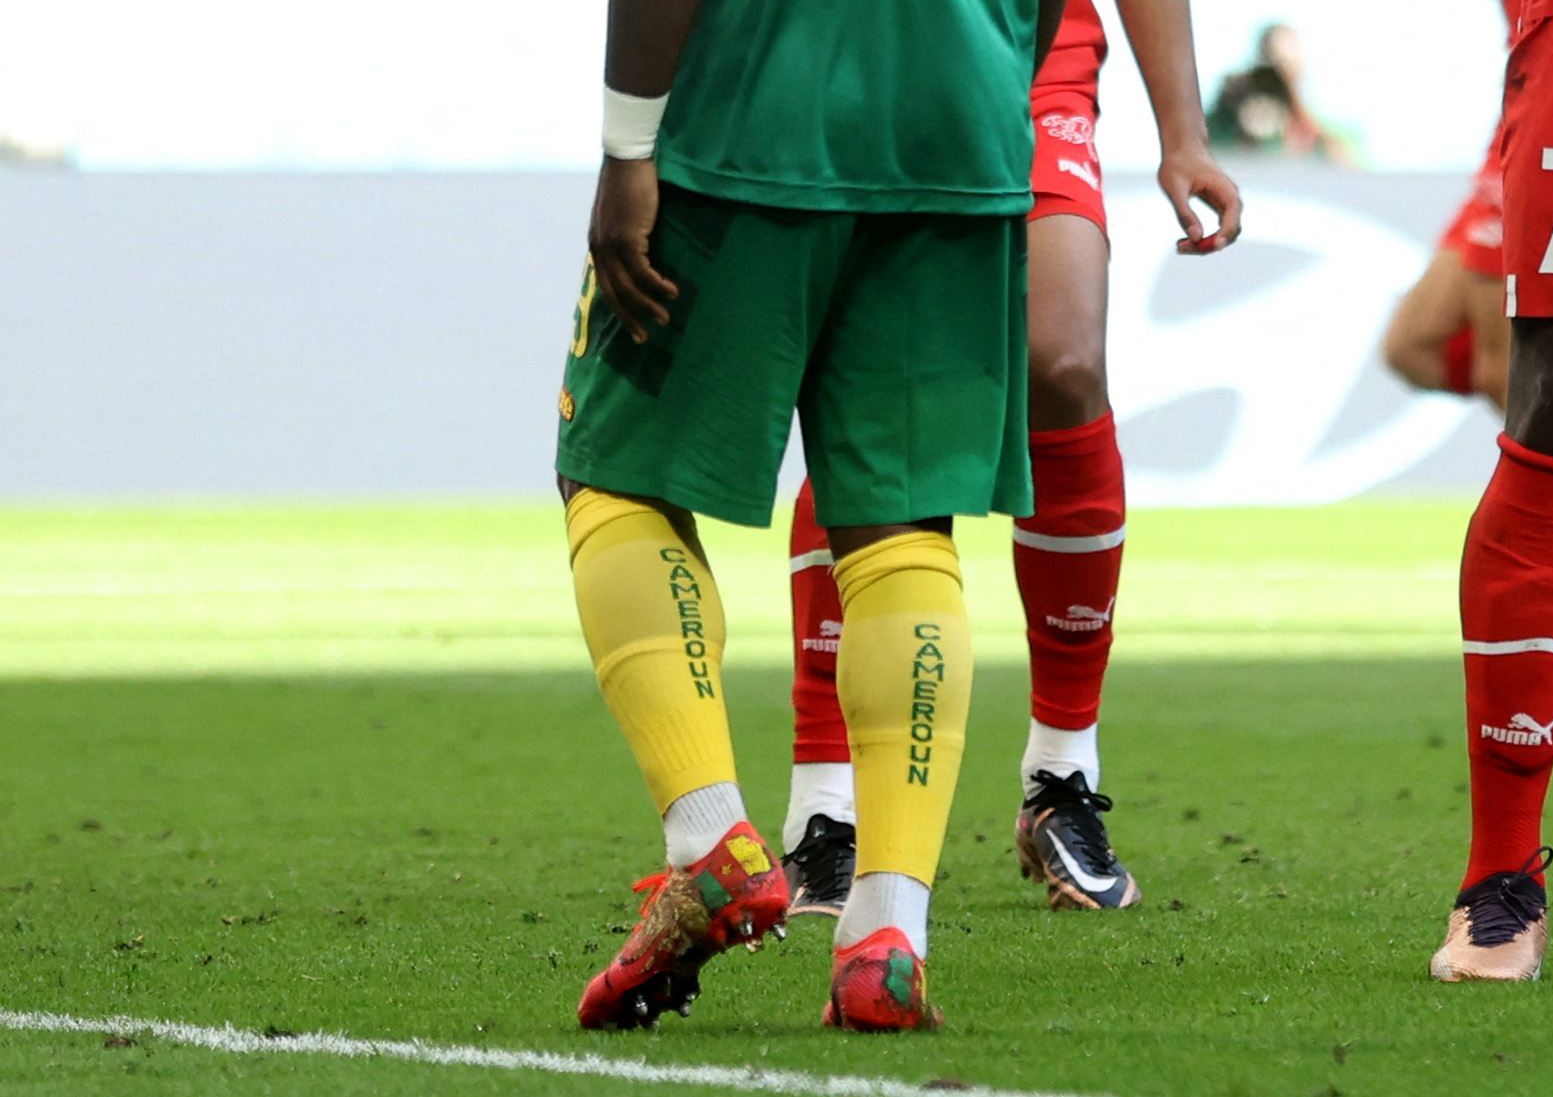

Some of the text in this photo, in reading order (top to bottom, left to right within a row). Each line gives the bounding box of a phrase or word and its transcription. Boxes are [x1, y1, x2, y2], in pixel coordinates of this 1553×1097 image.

[659, 547, 716, 700] CAMEROUN
[907, 623, 946, 787] CAMEROUN
[1481, 724, 1543, 747] PUMA
